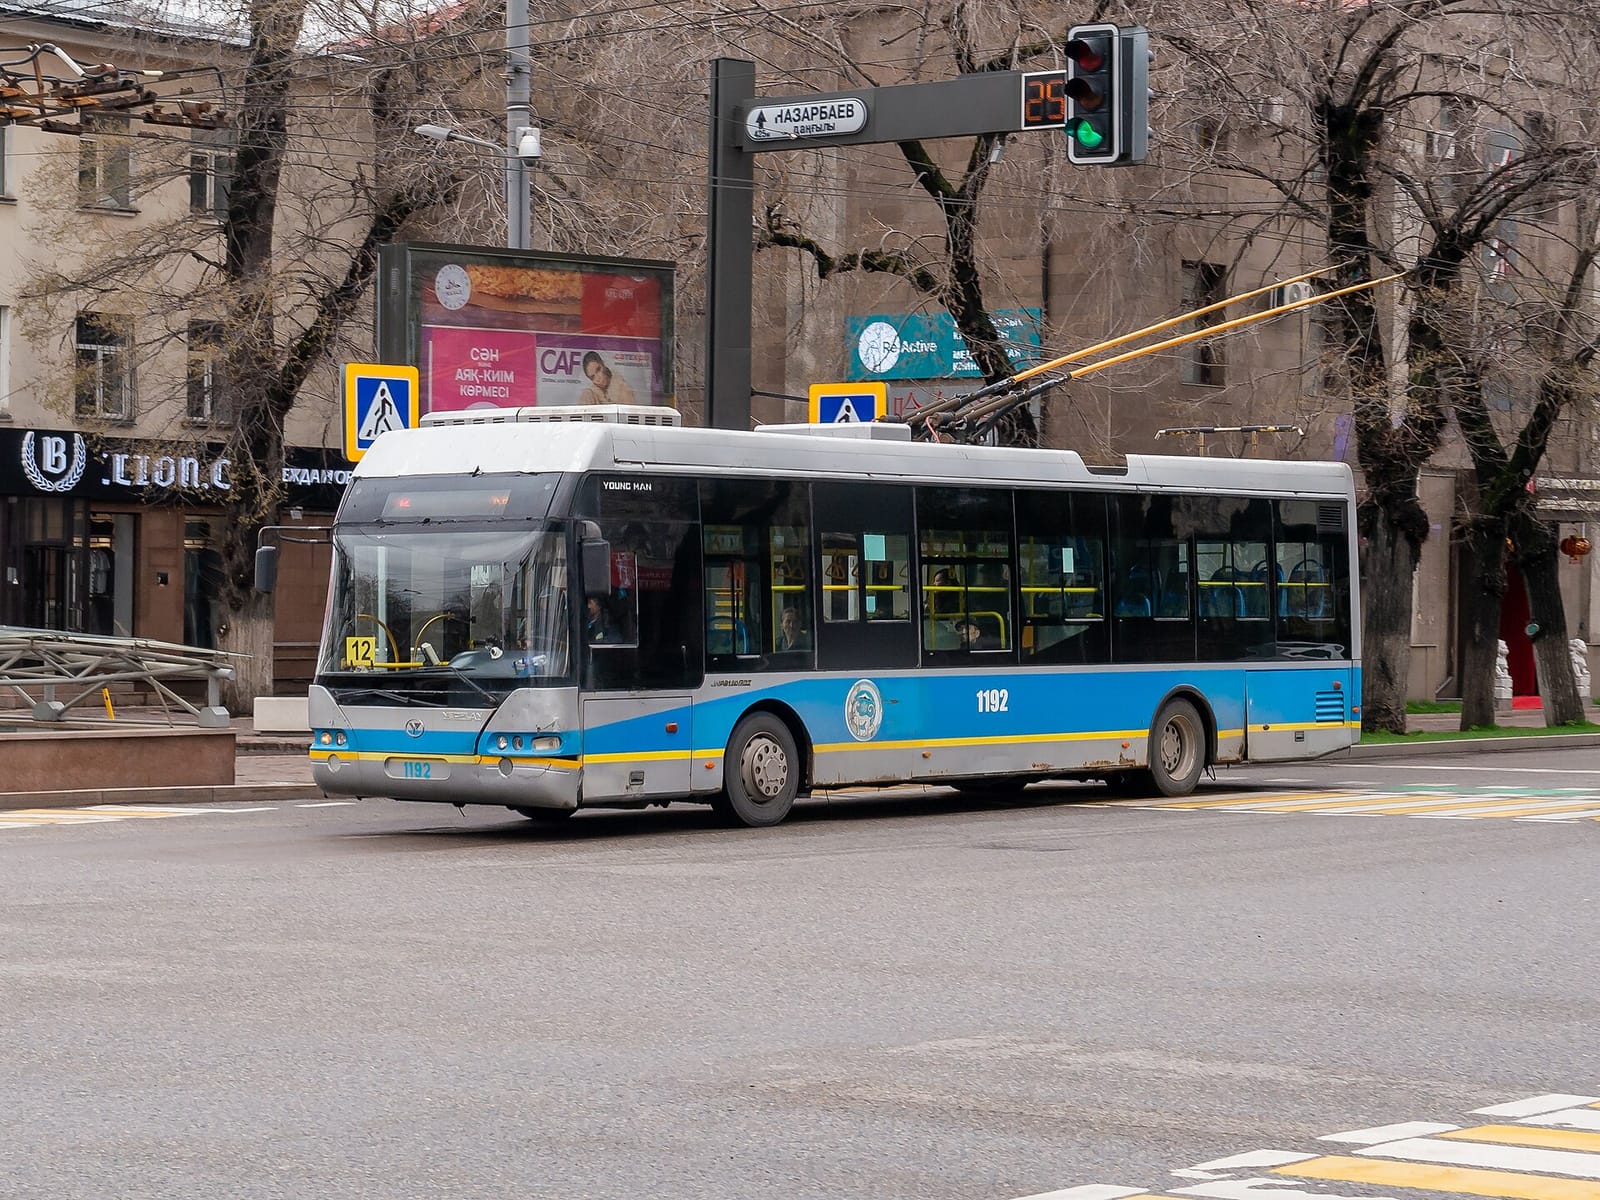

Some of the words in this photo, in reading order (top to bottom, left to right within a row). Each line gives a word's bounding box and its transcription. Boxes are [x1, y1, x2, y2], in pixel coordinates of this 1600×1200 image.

[1026, 79, 1065, 121] 25
[774, 103, 855, 124] НАЗАРБАЕВ
[470, 347, 499, 362] СӘН
[455, 368, 515, 384] АЯҚ-КИІМ
[460, 384, 510, 398] КӨРМЕСІ
[602, 481, 631, 491] YOUNG
[633, 482, 652, 491] MAN
[351, 639, 372, 661] 12
[976, 689, 1009, 713] 1192
[403, 761, 431, 778] 1192
